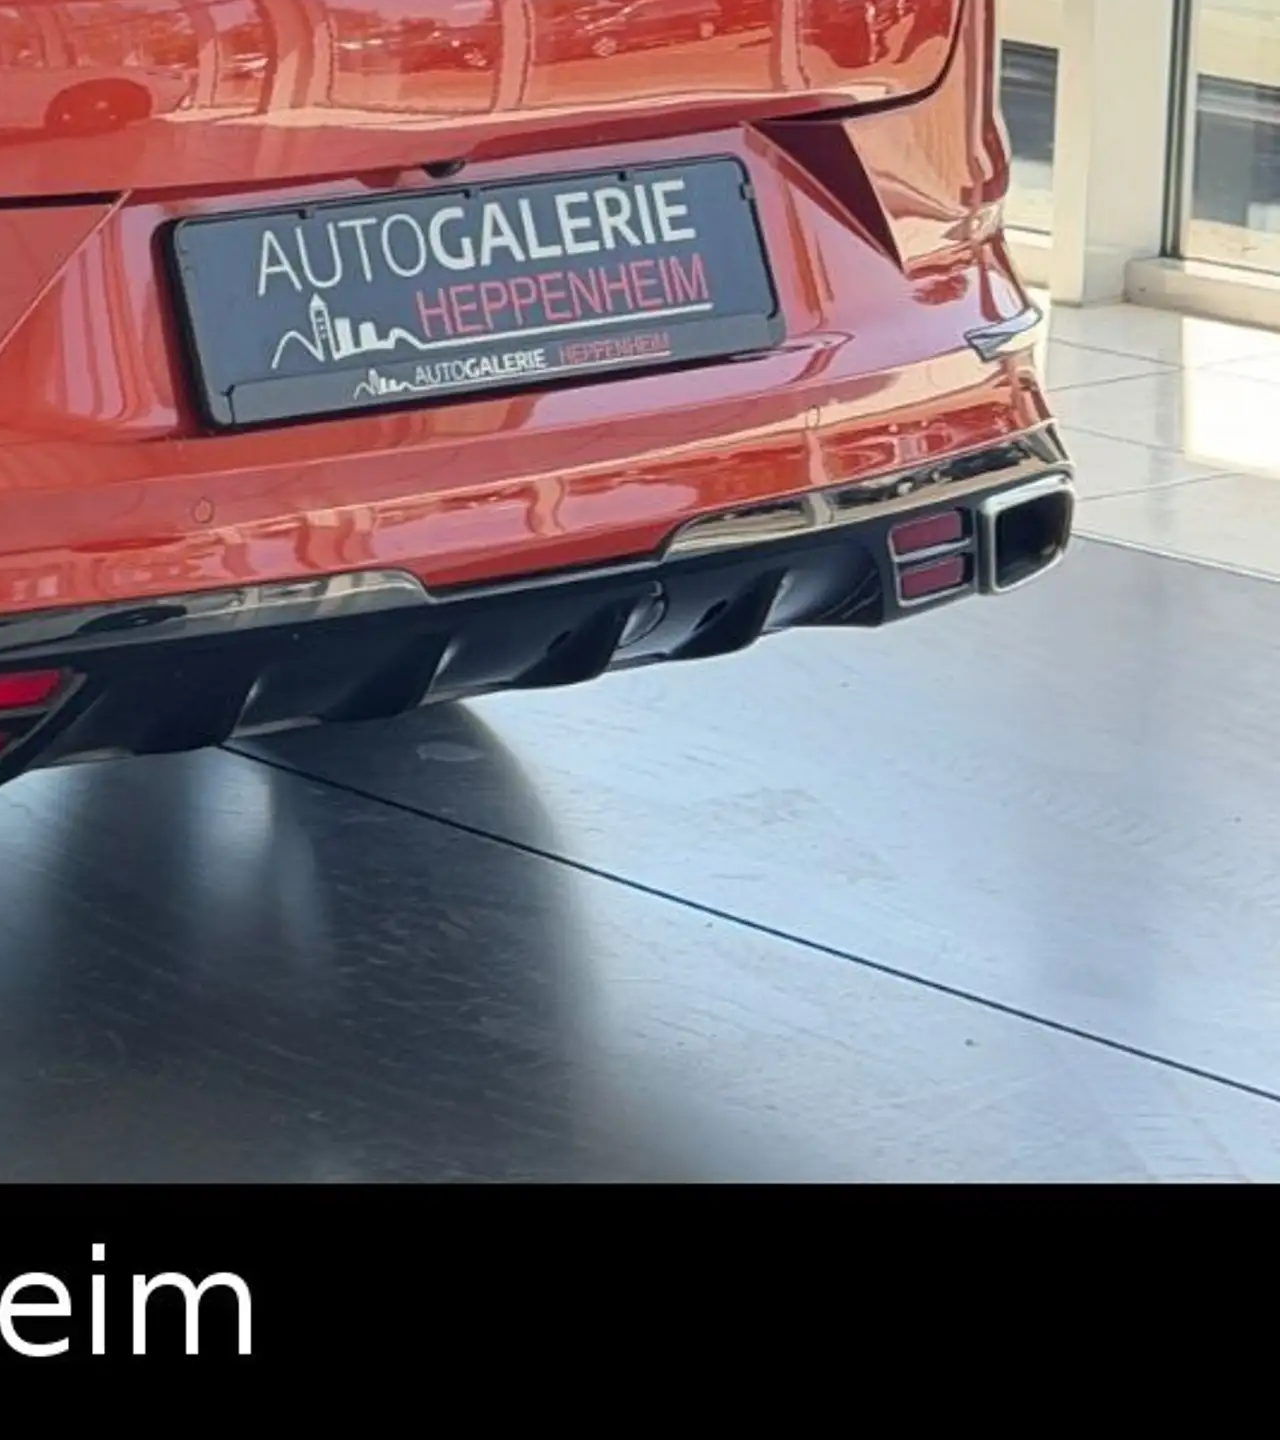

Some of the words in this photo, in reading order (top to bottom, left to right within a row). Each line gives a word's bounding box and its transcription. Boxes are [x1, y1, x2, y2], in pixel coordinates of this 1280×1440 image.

[257, 179, 697, 296] AUTOGALERIE
[416, 252, 710, 339] HEPPENHEIM
[415, 347, 547, 384] AUTOGALERIE
[558, 332, 670, 365] HEPPENHEIM
